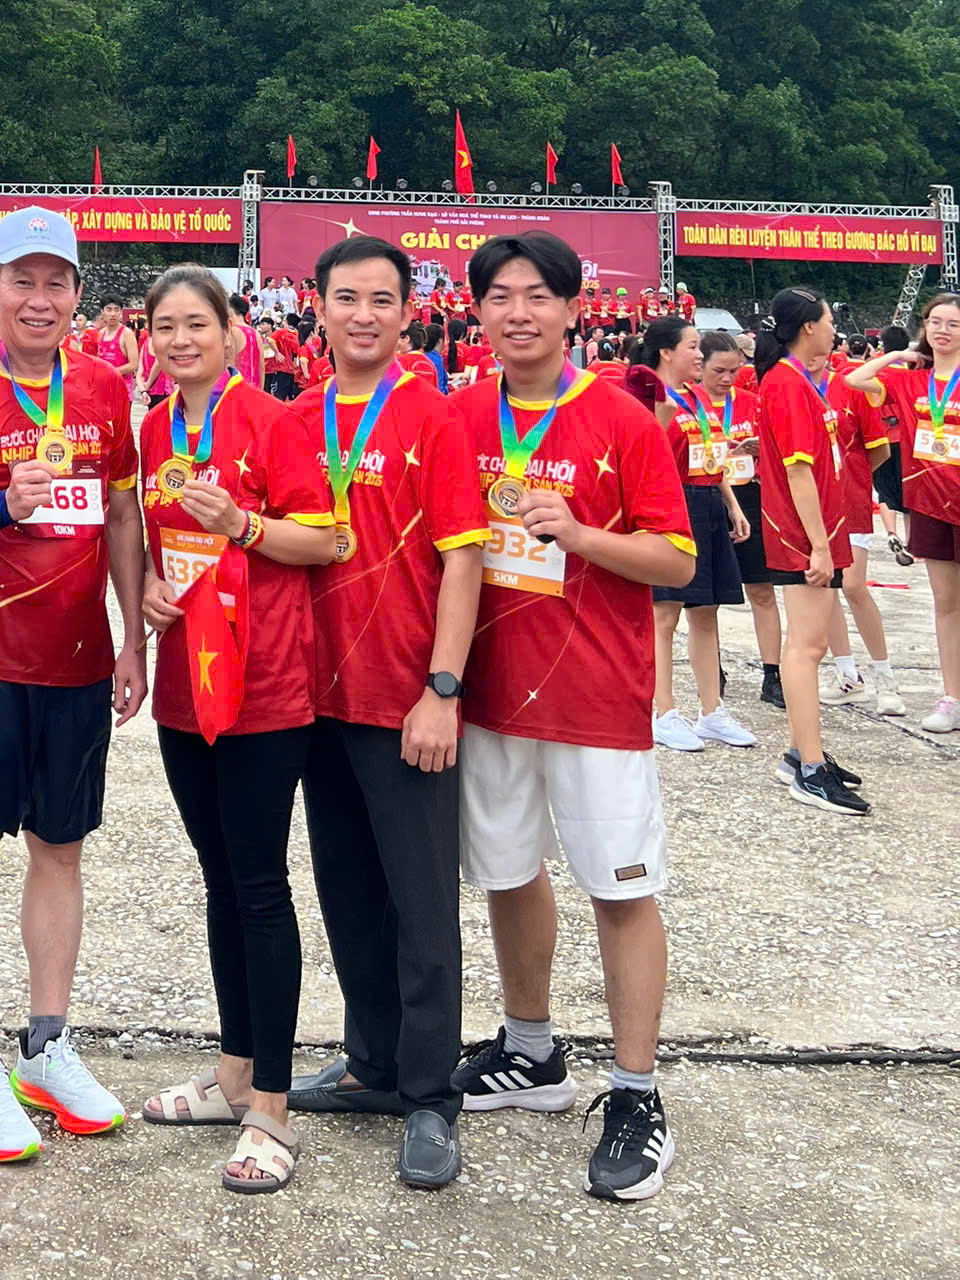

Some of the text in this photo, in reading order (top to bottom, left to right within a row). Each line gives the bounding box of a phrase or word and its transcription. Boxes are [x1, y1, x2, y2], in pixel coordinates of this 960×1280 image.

[81, 208, 102, 229] XÂY
[104, 210, 133, 232] DỰNG
[134, 209, 148, 230] VÀ
[150, 207, 171, 230] BẢO
[173, 210, 186, 234] VỆ
[203, 207, 232, 232] QUỐC
[400, 227, 498, 250] GIẢI CH
[683, 223, 707, 244] TOÀN
[708, 224, 728, 245] DÂN
[729, 224, 747, 246] RÈN
[749, 225, 777, 251] LUYỆN
[778, 227, 801, 248] THÂN
[803, 224, 820, 248] THỂ
[821, 231, 843, 249] THEO
[845, 231, 875, 250] GƯƠNG
[877, 230, 895, 251] BÁC
[910, 231, 920, 252] VĨ
[921, 234, 937, 256] ĐẠI
[358, 449, 385, 473] HỘI
[692, 446, 721, 461] 573
[545, 459, 576, 483] HỘI
[42, 486, 88, 510] 68
[143, 490, 160, 509] HỊP
[53, 525, 76, 536] 10KM
[494, 572, 519, 585] 5KM
